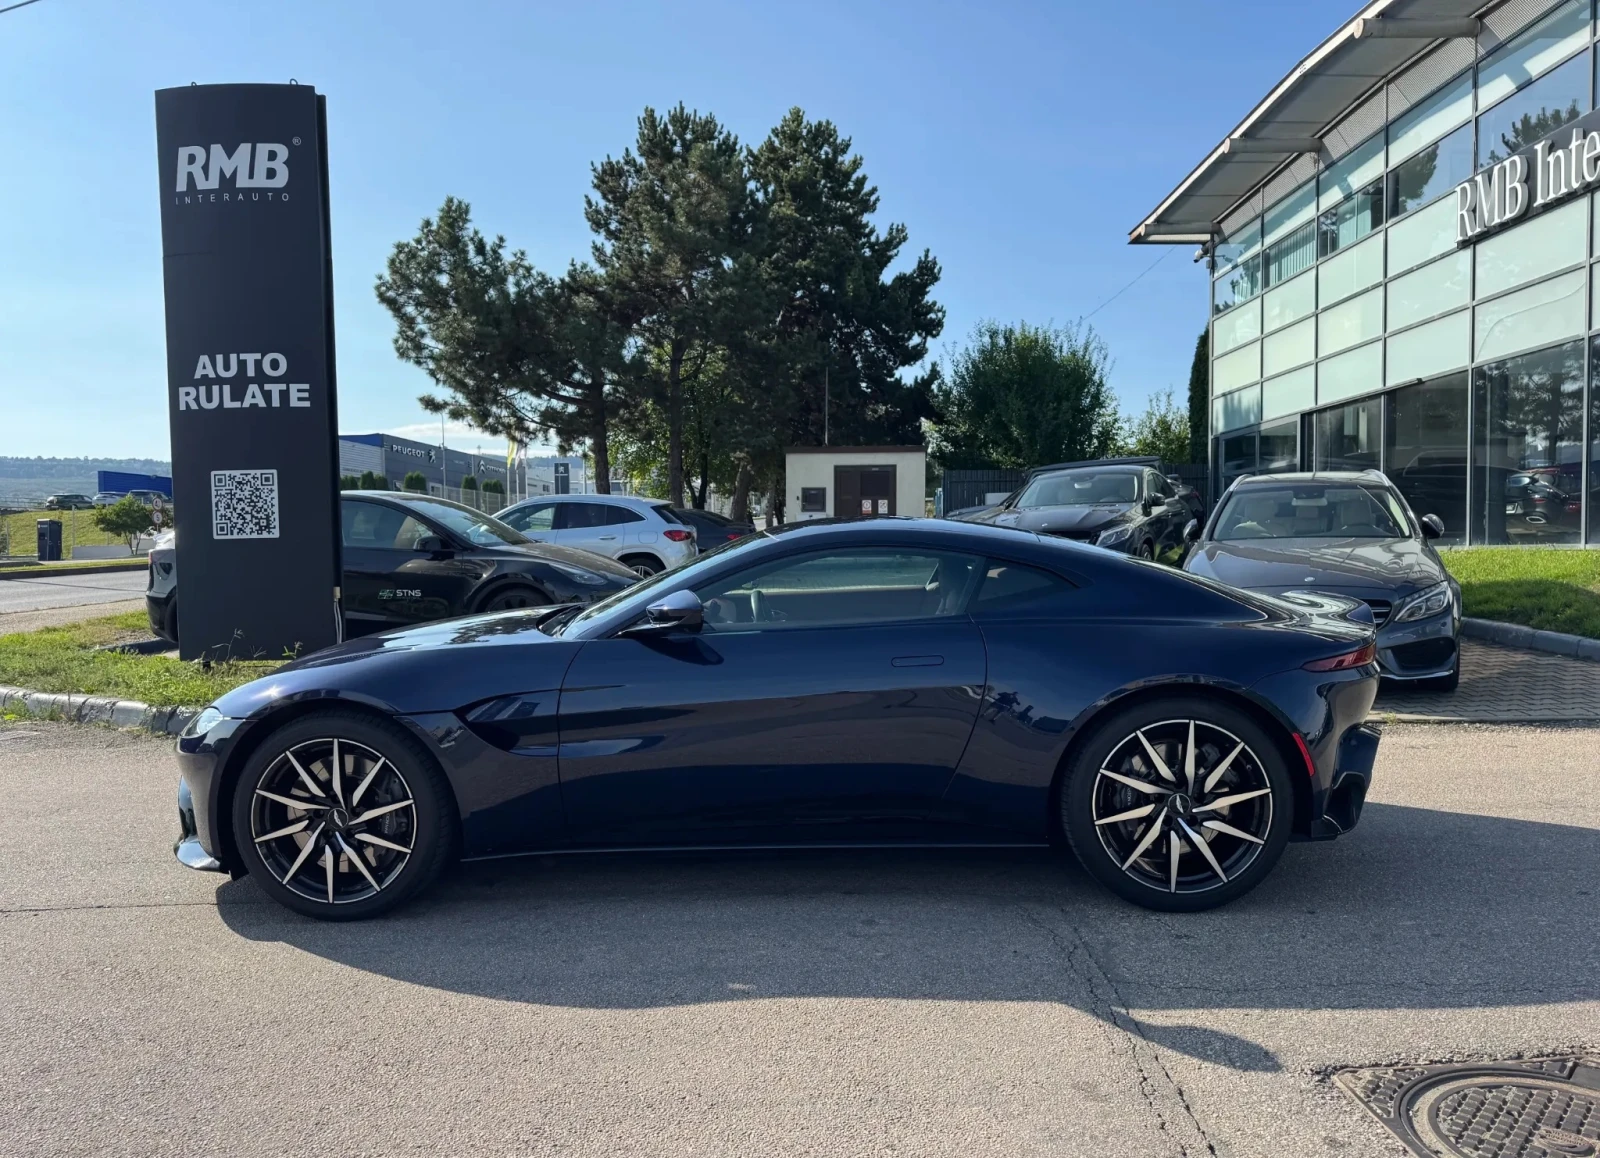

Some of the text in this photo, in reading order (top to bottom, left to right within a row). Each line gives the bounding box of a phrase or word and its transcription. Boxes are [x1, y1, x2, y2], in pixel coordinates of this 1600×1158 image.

[176, 143, 289, 192] RMB
[175, 192, 289, 205] INTERAUTO
[1454, 155, 1528, 243] RMB
[193, 352, 288, 379] AUTO
[178, 383, 311, 411] RULATE
[392, 444, 425, 458] PEUGEOT
[396, 589, 421, 597] STNS
